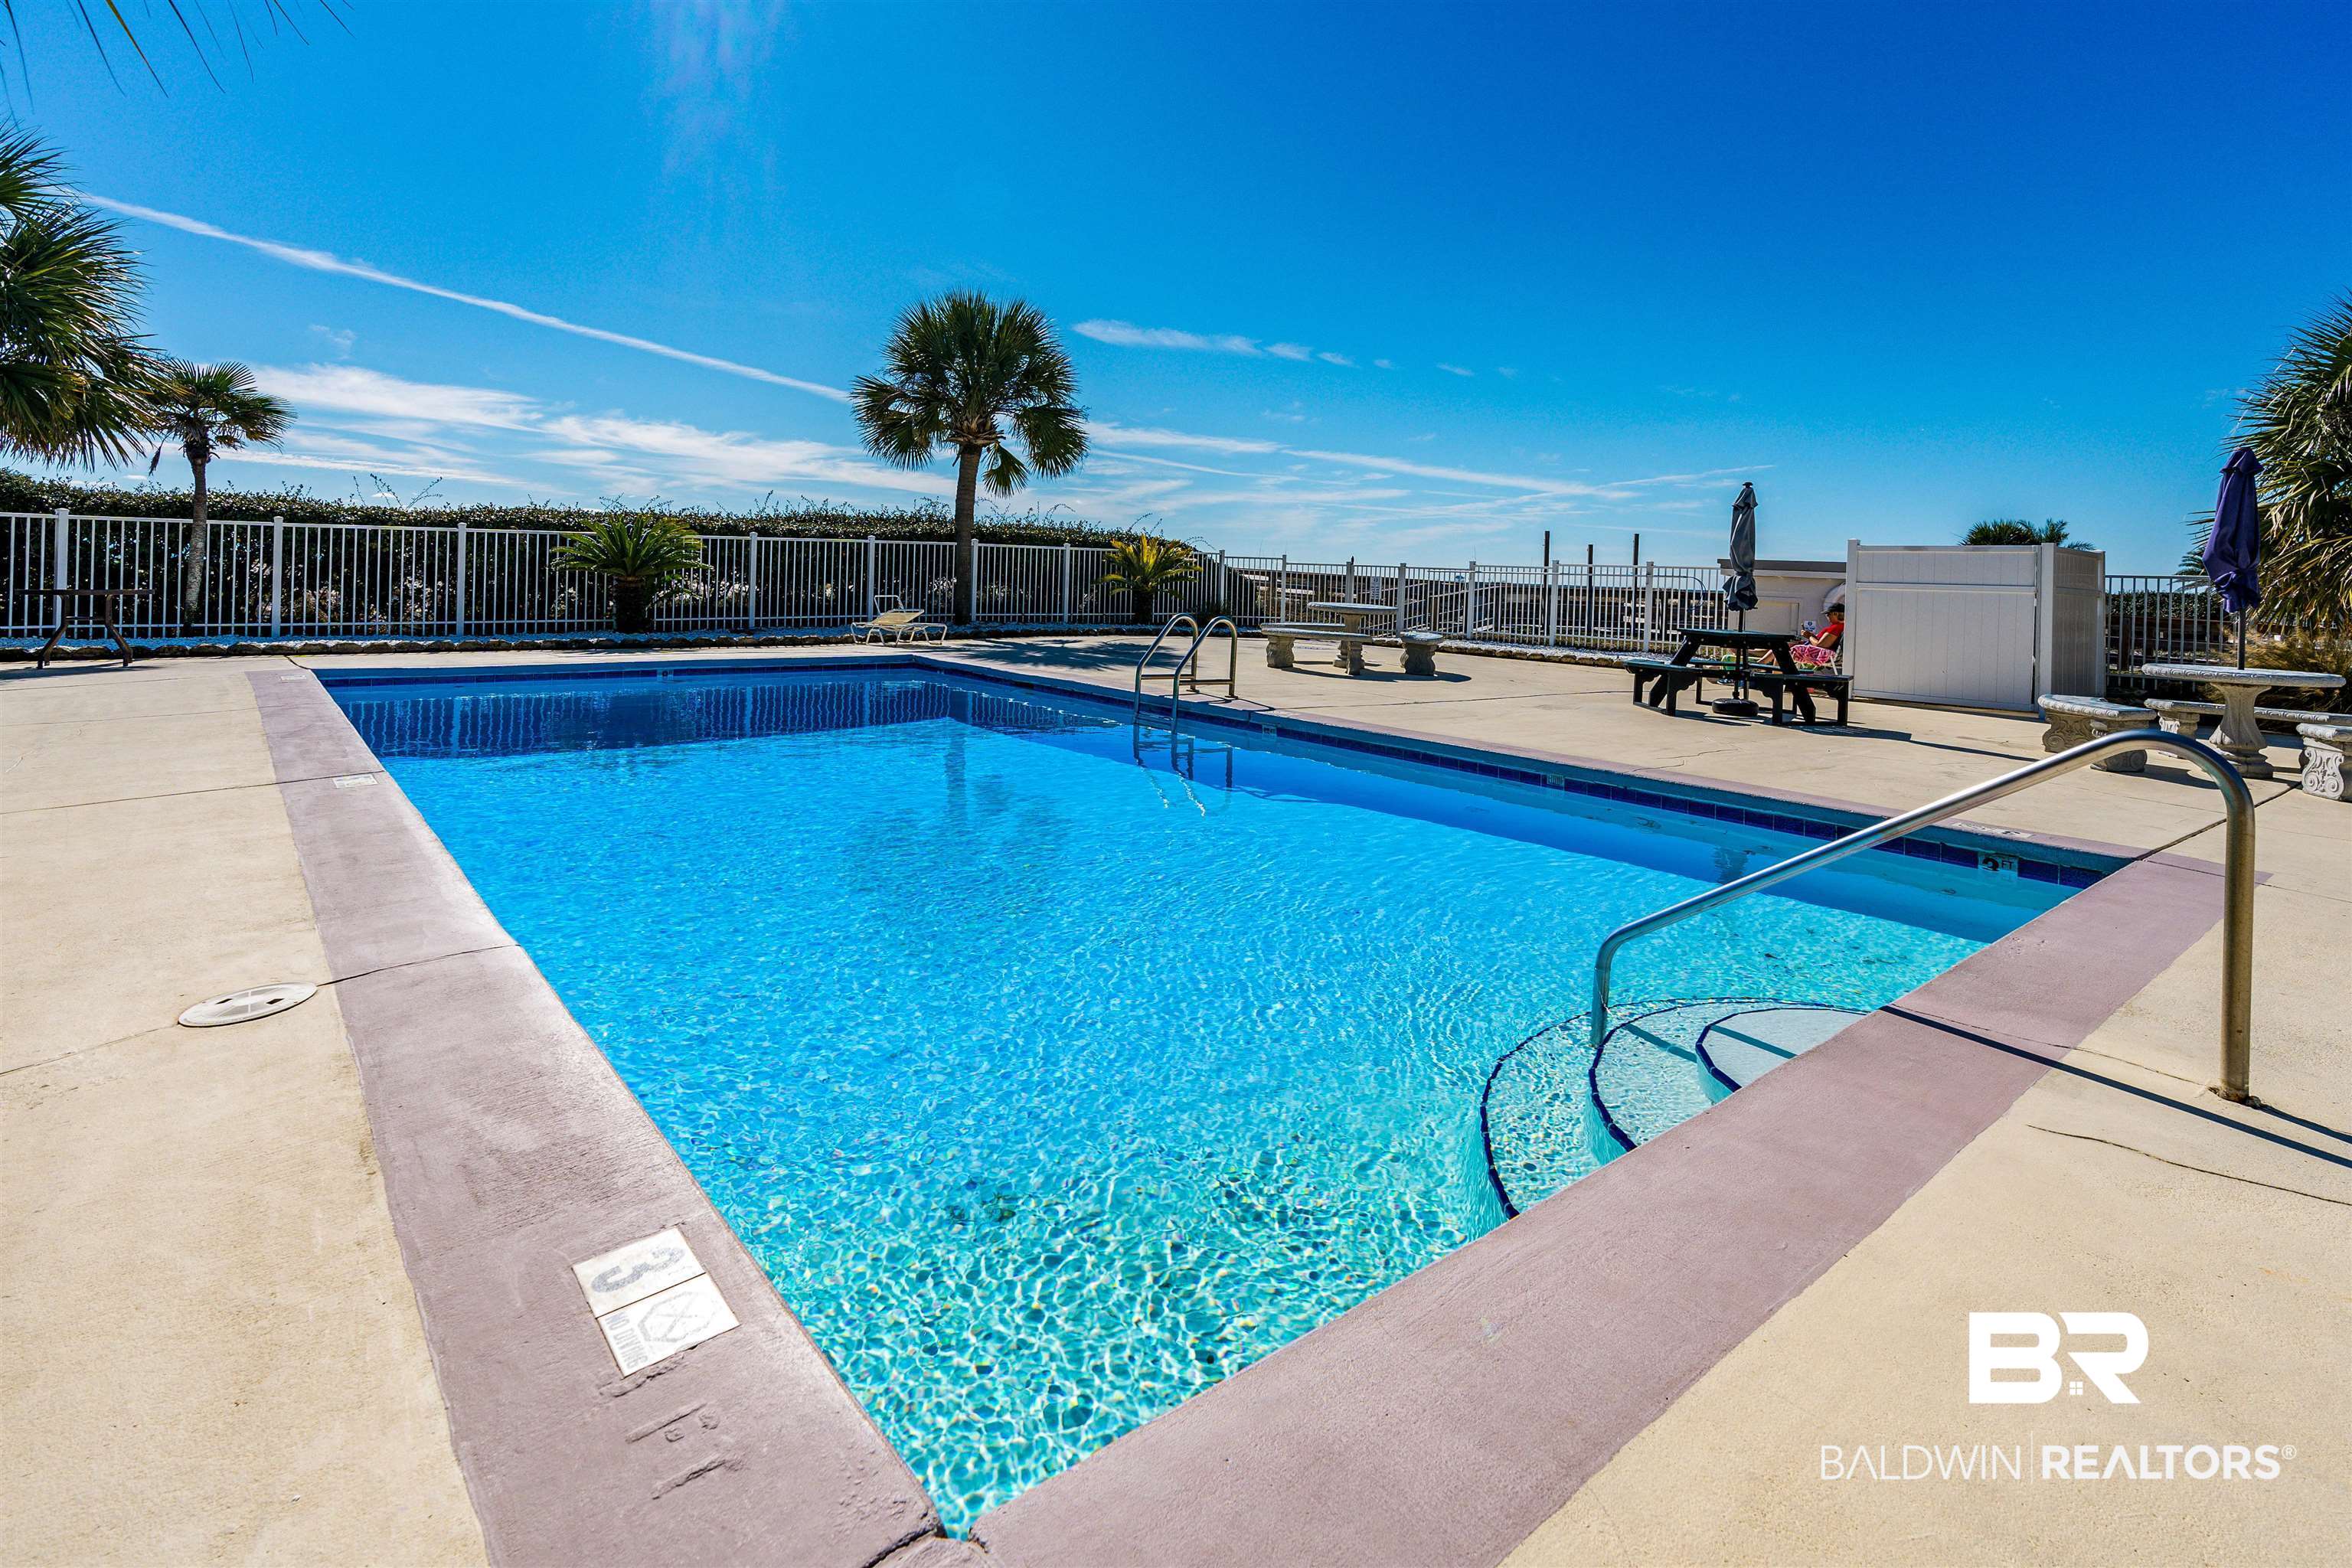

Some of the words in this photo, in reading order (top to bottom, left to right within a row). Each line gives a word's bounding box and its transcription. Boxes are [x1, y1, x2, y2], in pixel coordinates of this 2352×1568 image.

[591, 1247, 685, 1292] 3
[606, 1312, 629, 1330] NO
[613, 1328, 648, 1369] DIVING
